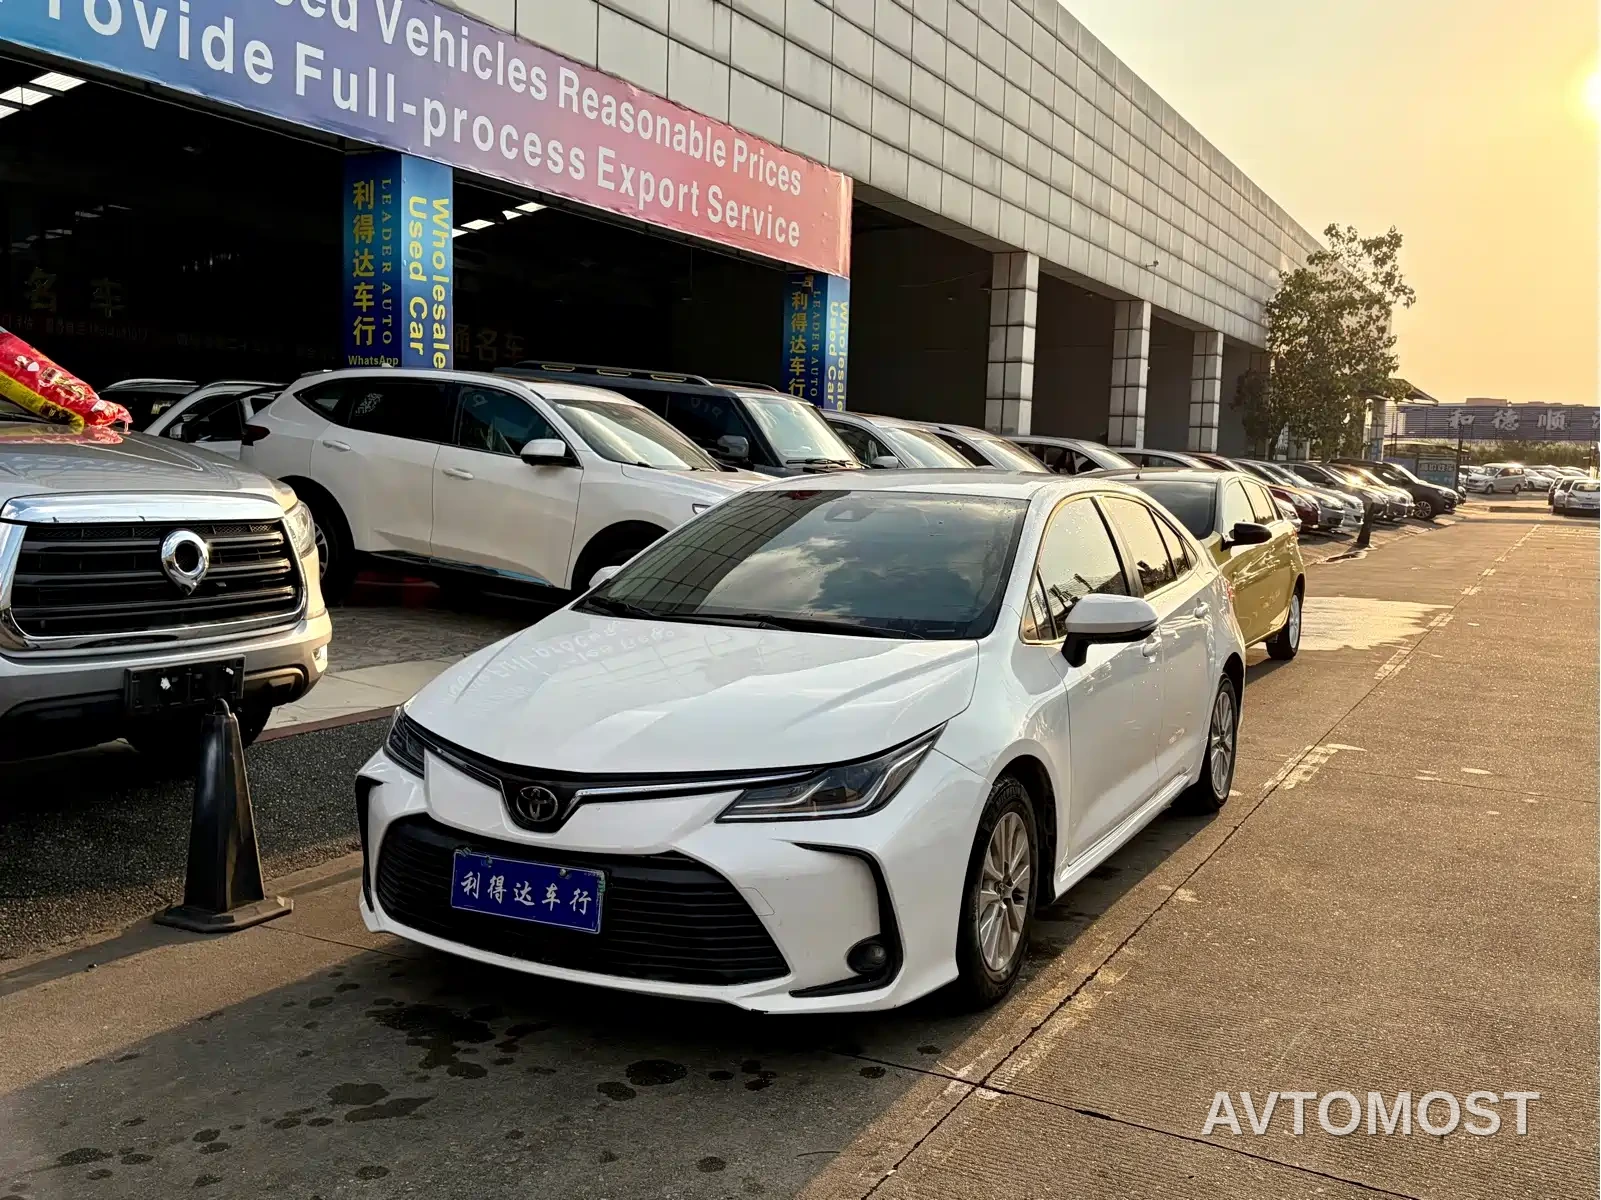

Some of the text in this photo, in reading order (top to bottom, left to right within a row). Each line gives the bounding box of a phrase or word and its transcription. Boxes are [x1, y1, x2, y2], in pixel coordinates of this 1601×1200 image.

[296, 42, 585, 181] Full-process
[597, 146, 700, 217] Export
[706, 185, 800, 247] Service
[376, 0, 547, 101] Vehicles
[558, 66, 727, 168] Reasonable
[733, 137, 802, 196] Prices
[353, 179, 376, 346] 利得达车行
[381, 178, 393, 345] LEADER AUTO
[409, 195, 428, 356] Used Car
[432, 198, 450, 370] Wholesale
[348, 355, 399, 368] WhatsApp
[789, 290, 808, 398] 利得达车行
[810, 290, 822, 397] LEADER AUTO
[827, 301, 839, 404] Used Car
[837, 301, 849, 412] Wholesale
[461, 871, 592, 915] 利得达车行
